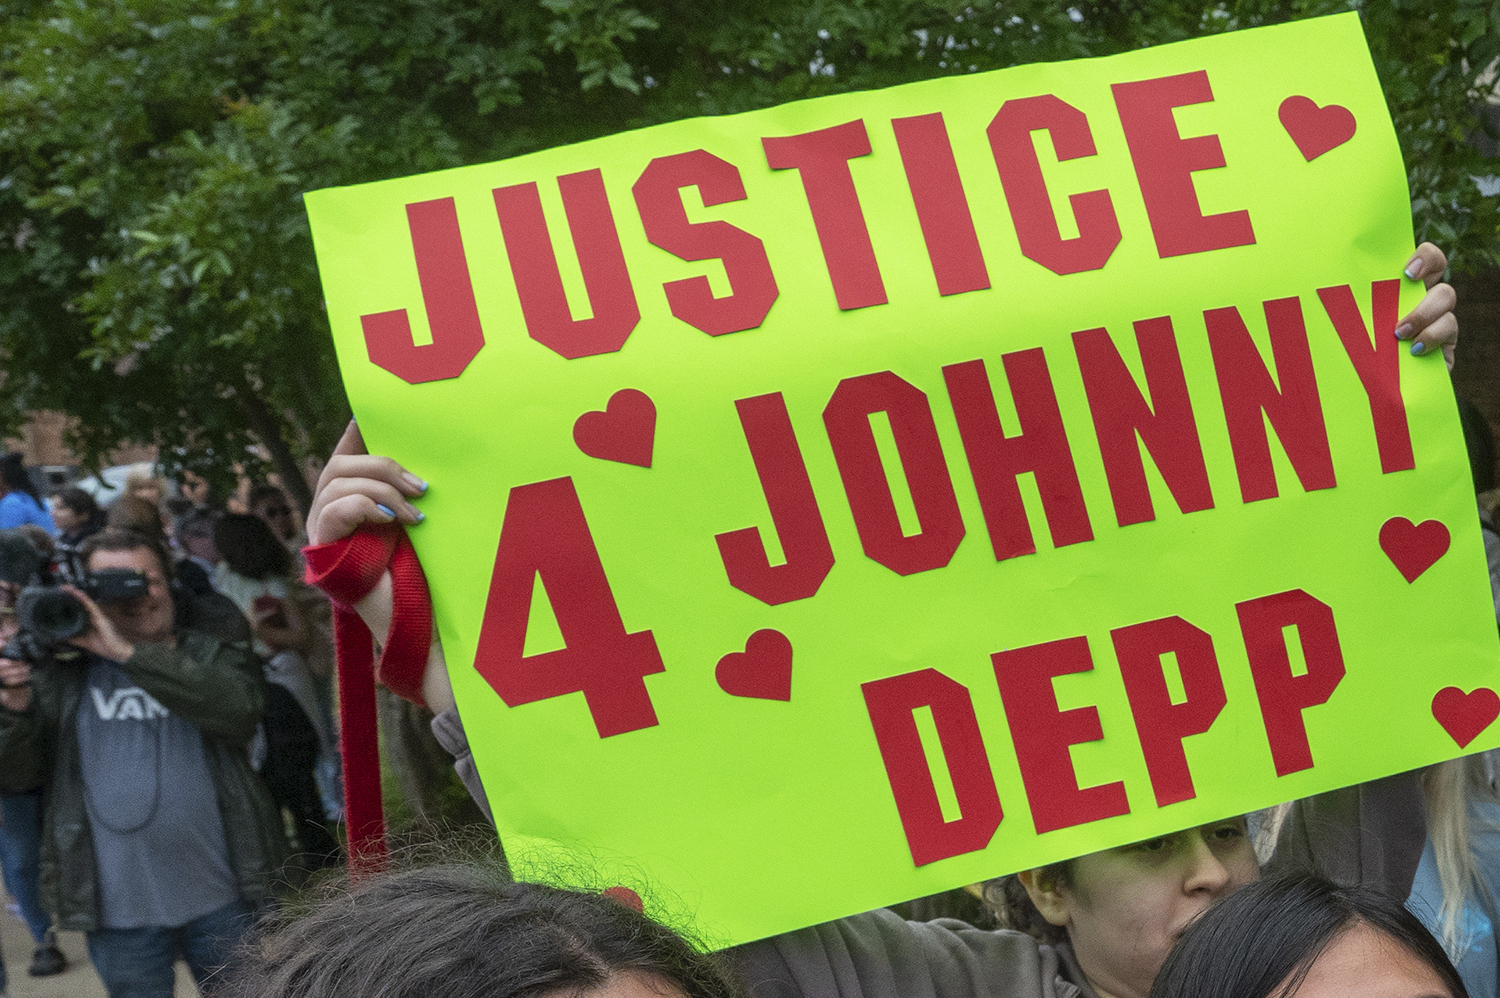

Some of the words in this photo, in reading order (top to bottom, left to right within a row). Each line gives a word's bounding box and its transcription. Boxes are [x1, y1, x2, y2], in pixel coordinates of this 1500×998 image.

[359, 69, 1257, 386] JUSTICE
[473, 475, 667, 739] 4
[714, 278, 1417, 607] JOHNNY
[860, 587, 1347, 868] DEPP
